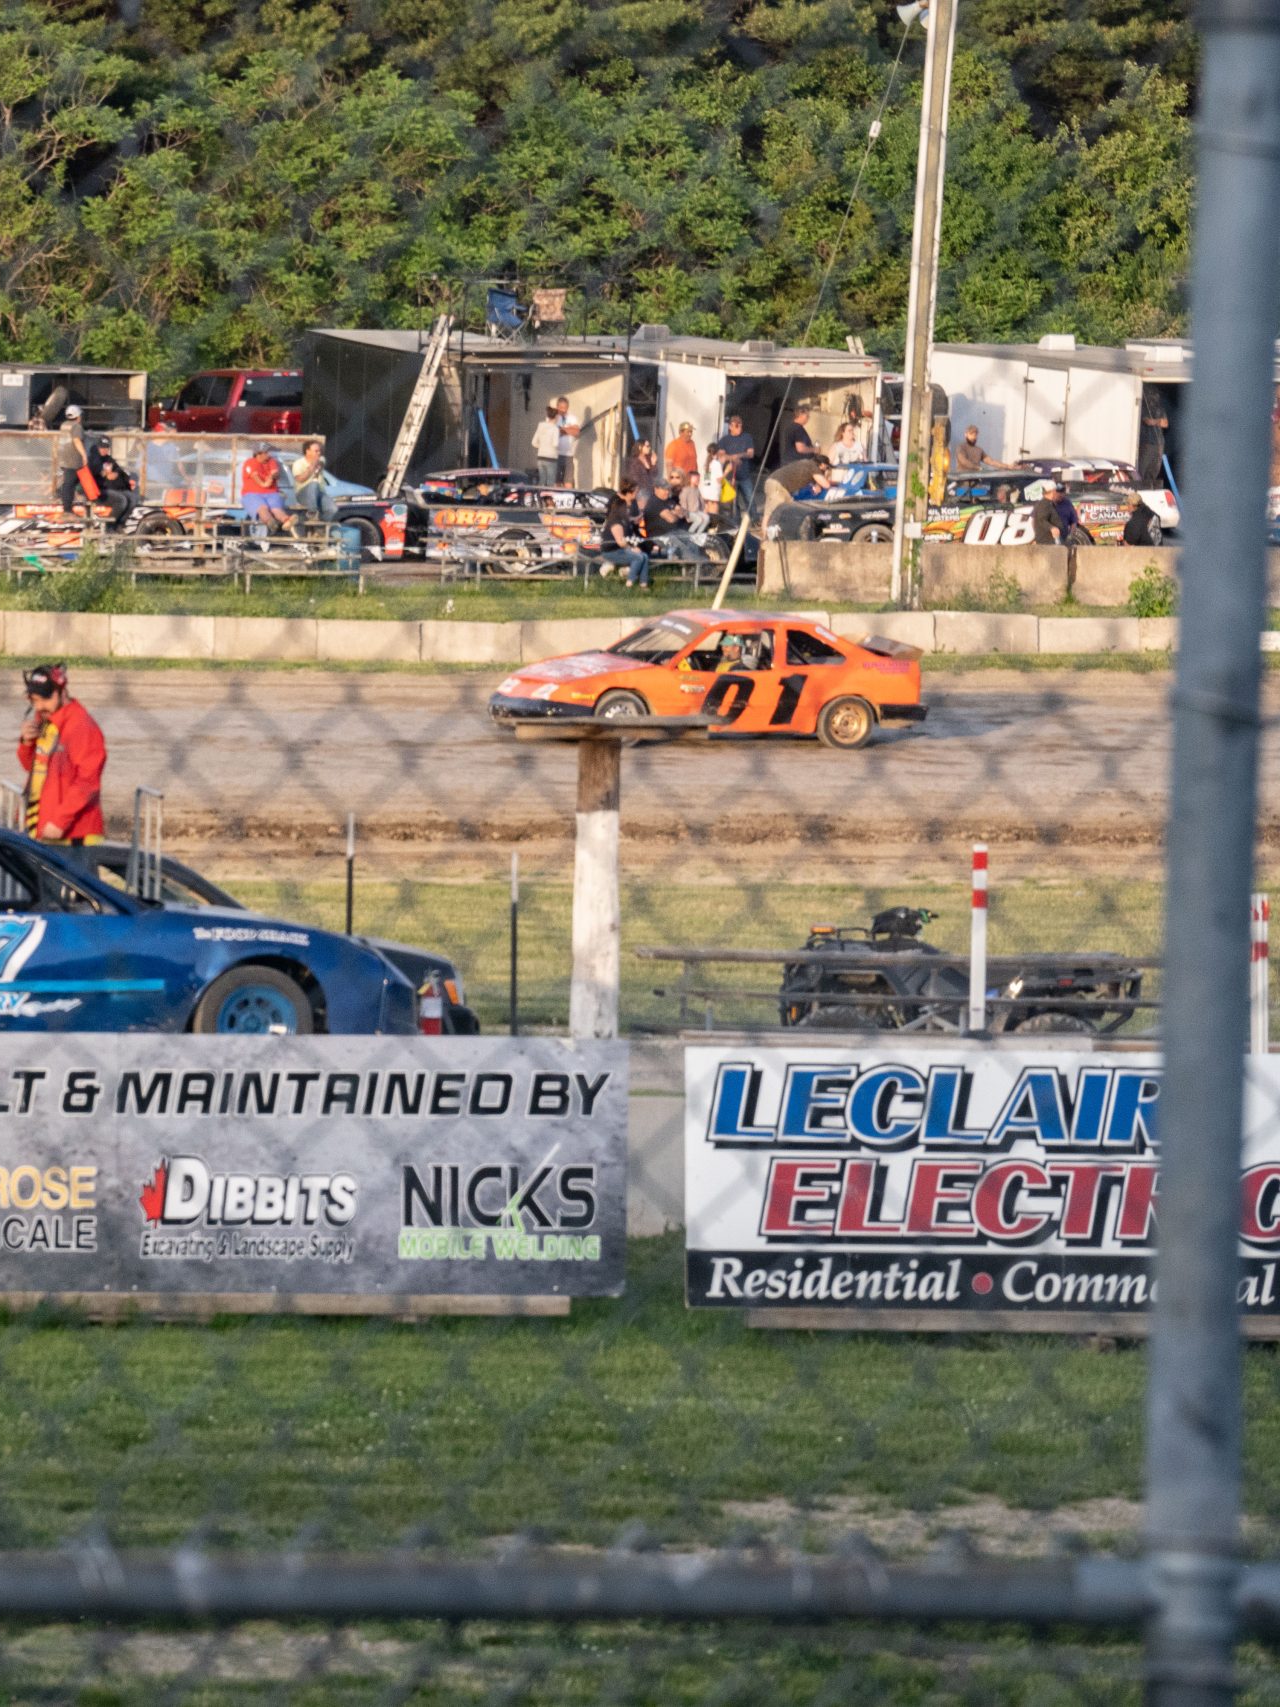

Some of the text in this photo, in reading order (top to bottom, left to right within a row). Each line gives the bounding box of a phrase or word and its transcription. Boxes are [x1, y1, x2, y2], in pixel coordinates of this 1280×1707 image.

[963, 505, 1036, 545] 08
[700, 673, 808, 726] 01
[60, 1069, 105, 1116] &
[116, 1070, 516, 1118] MAINTAINED
[524, 1070, 612, 1118] BY
[401, 1163, 599, 1229] NICKS
[140, 1232, 356, 1263] Excavating & Landscape Supply
[398, 1234, 601, 1261] MOBILE WELDING
[706, 1257, 960, 1301] Residential
